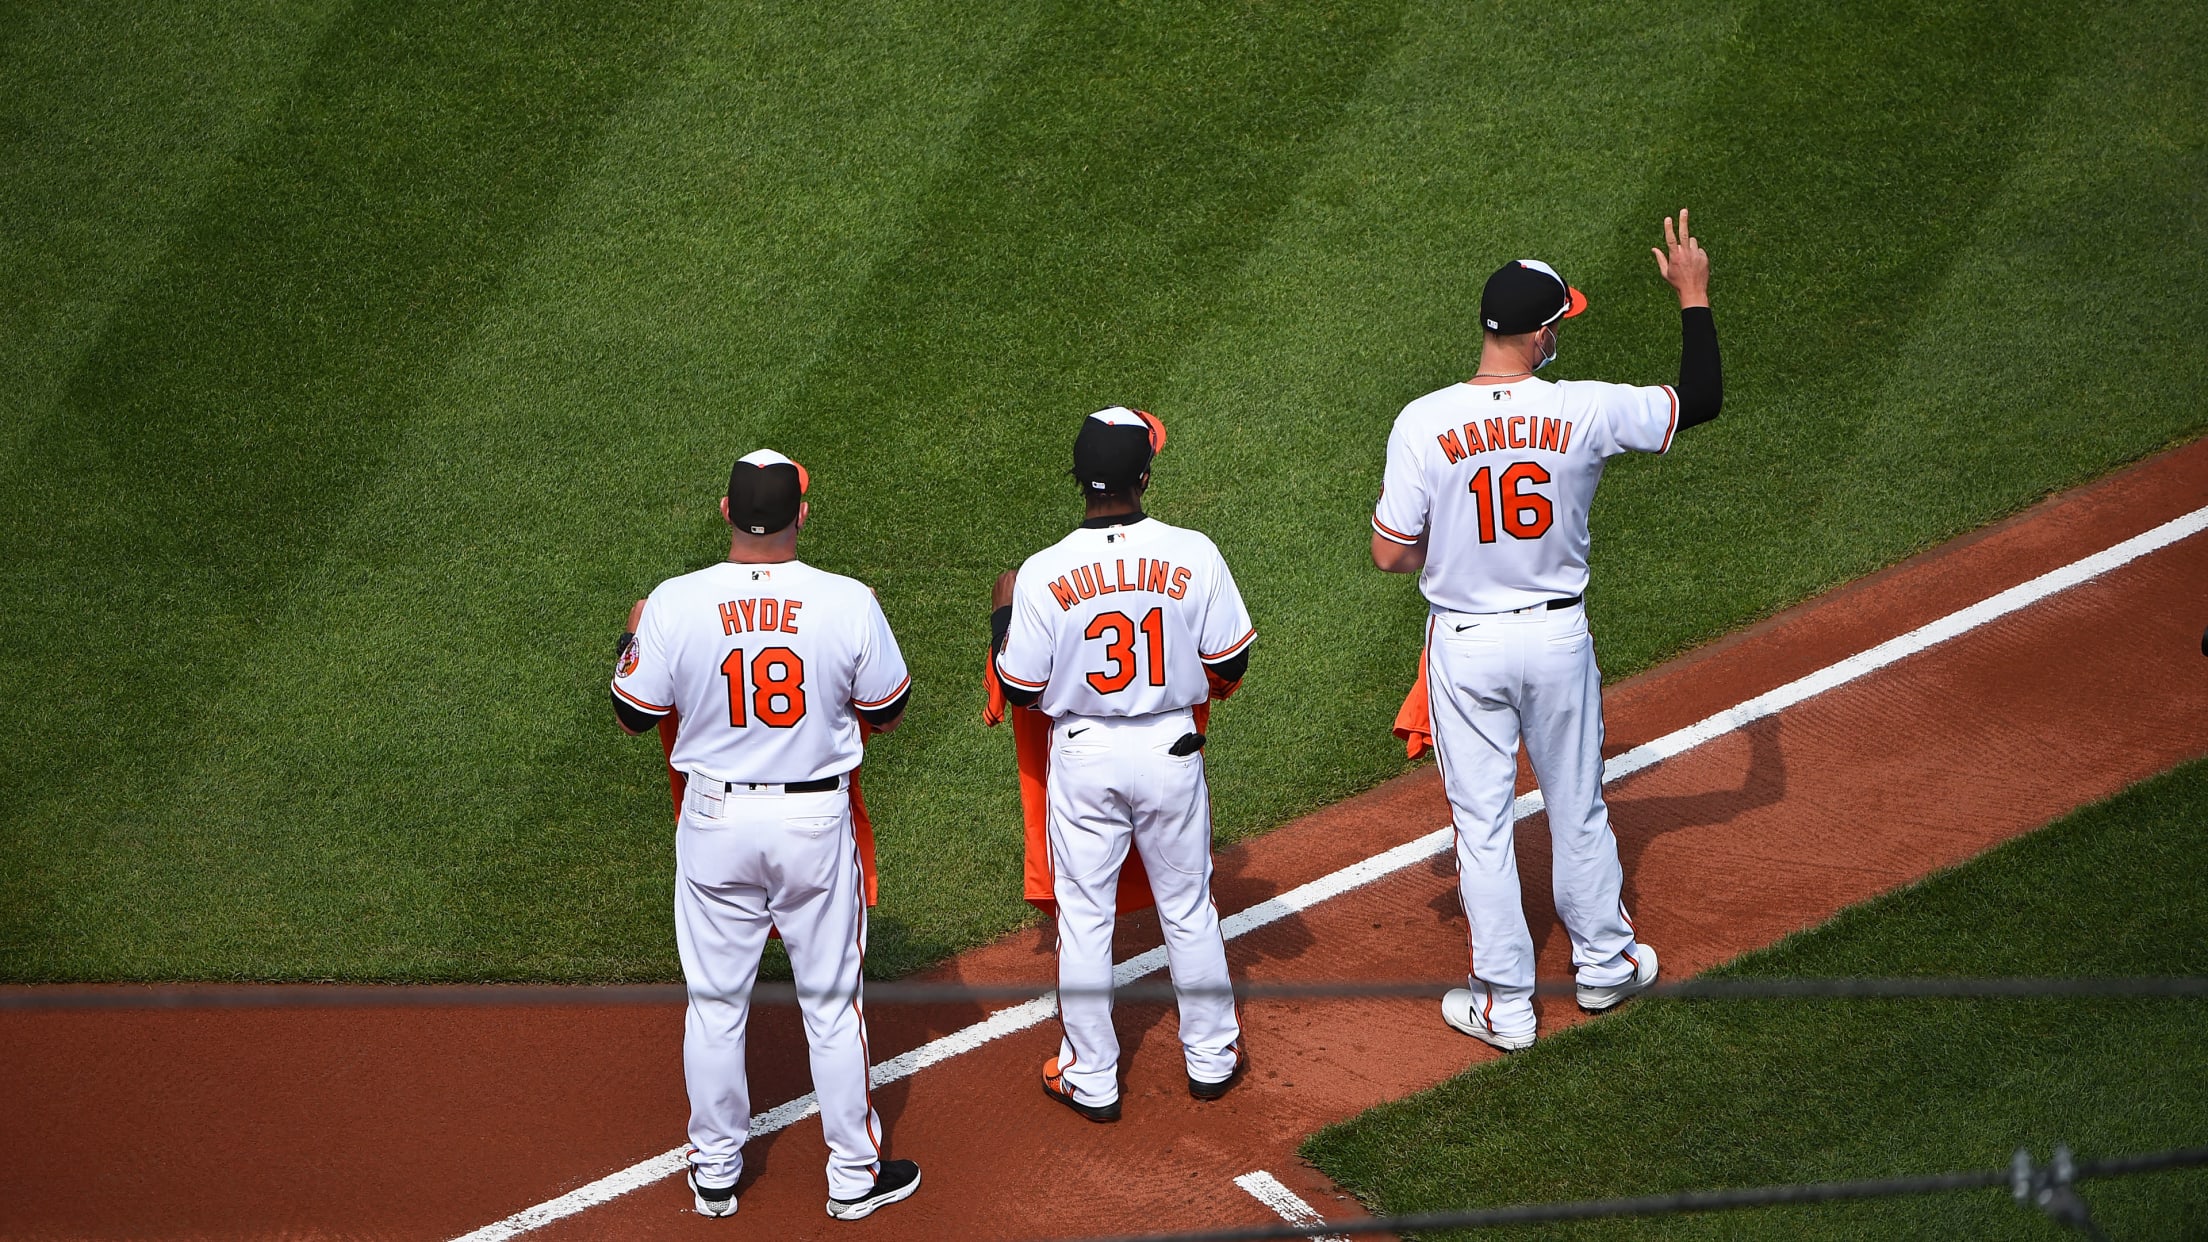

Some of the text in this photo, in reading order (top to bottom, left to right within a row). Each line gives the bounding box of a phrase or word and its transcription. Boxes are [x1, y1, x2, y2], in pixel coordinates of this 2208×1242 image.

[1436, 415, 1572, 465] MANCINI
[1468, 461, 1553, 544] 16
[718, 598, 802, 635] HYDE
[1048, 558, 1192, 611] MULLINS
[1084, 607, 1166, 695] 31
[720, 647, 806, 728] 18
